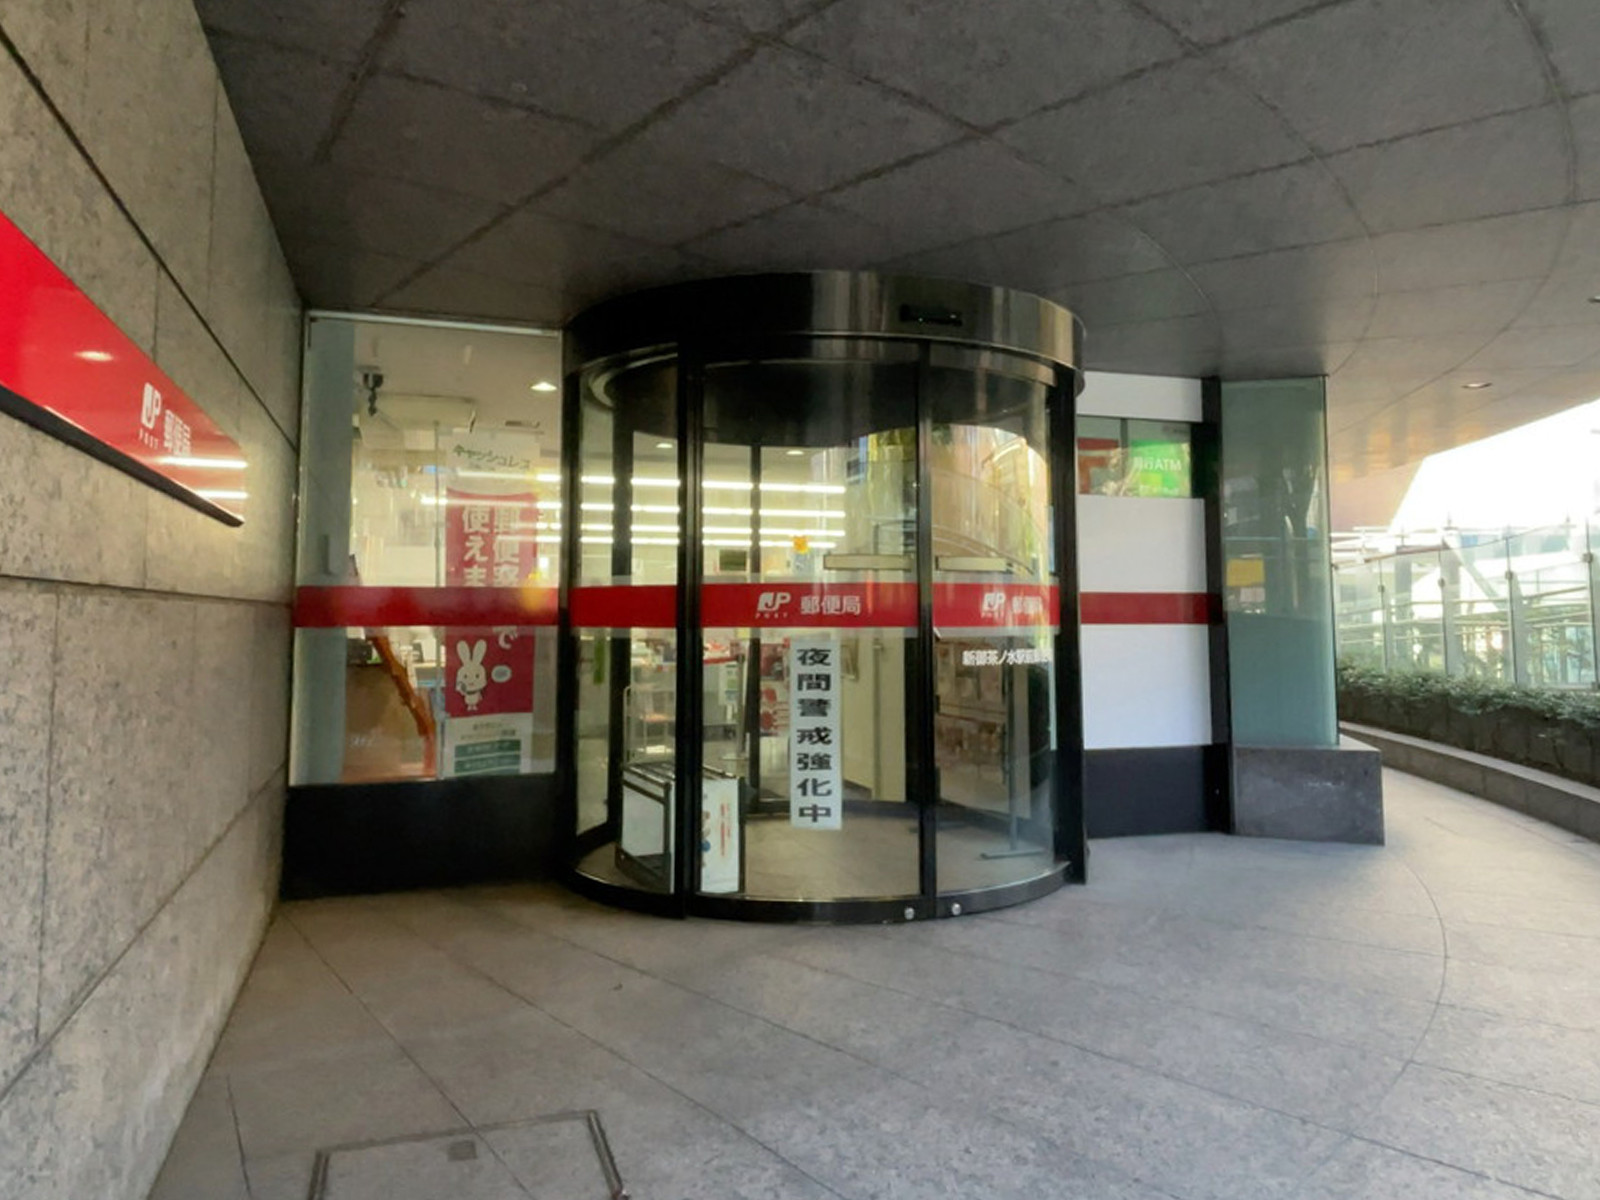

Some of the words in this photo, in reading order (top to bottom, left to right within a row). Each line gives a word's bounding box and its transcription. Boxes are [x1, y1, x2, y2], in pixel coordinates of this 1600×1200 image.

[800, 595, 861, 615] 郵便局
[797, 648, 832, 823] 夜間警戒強化中
